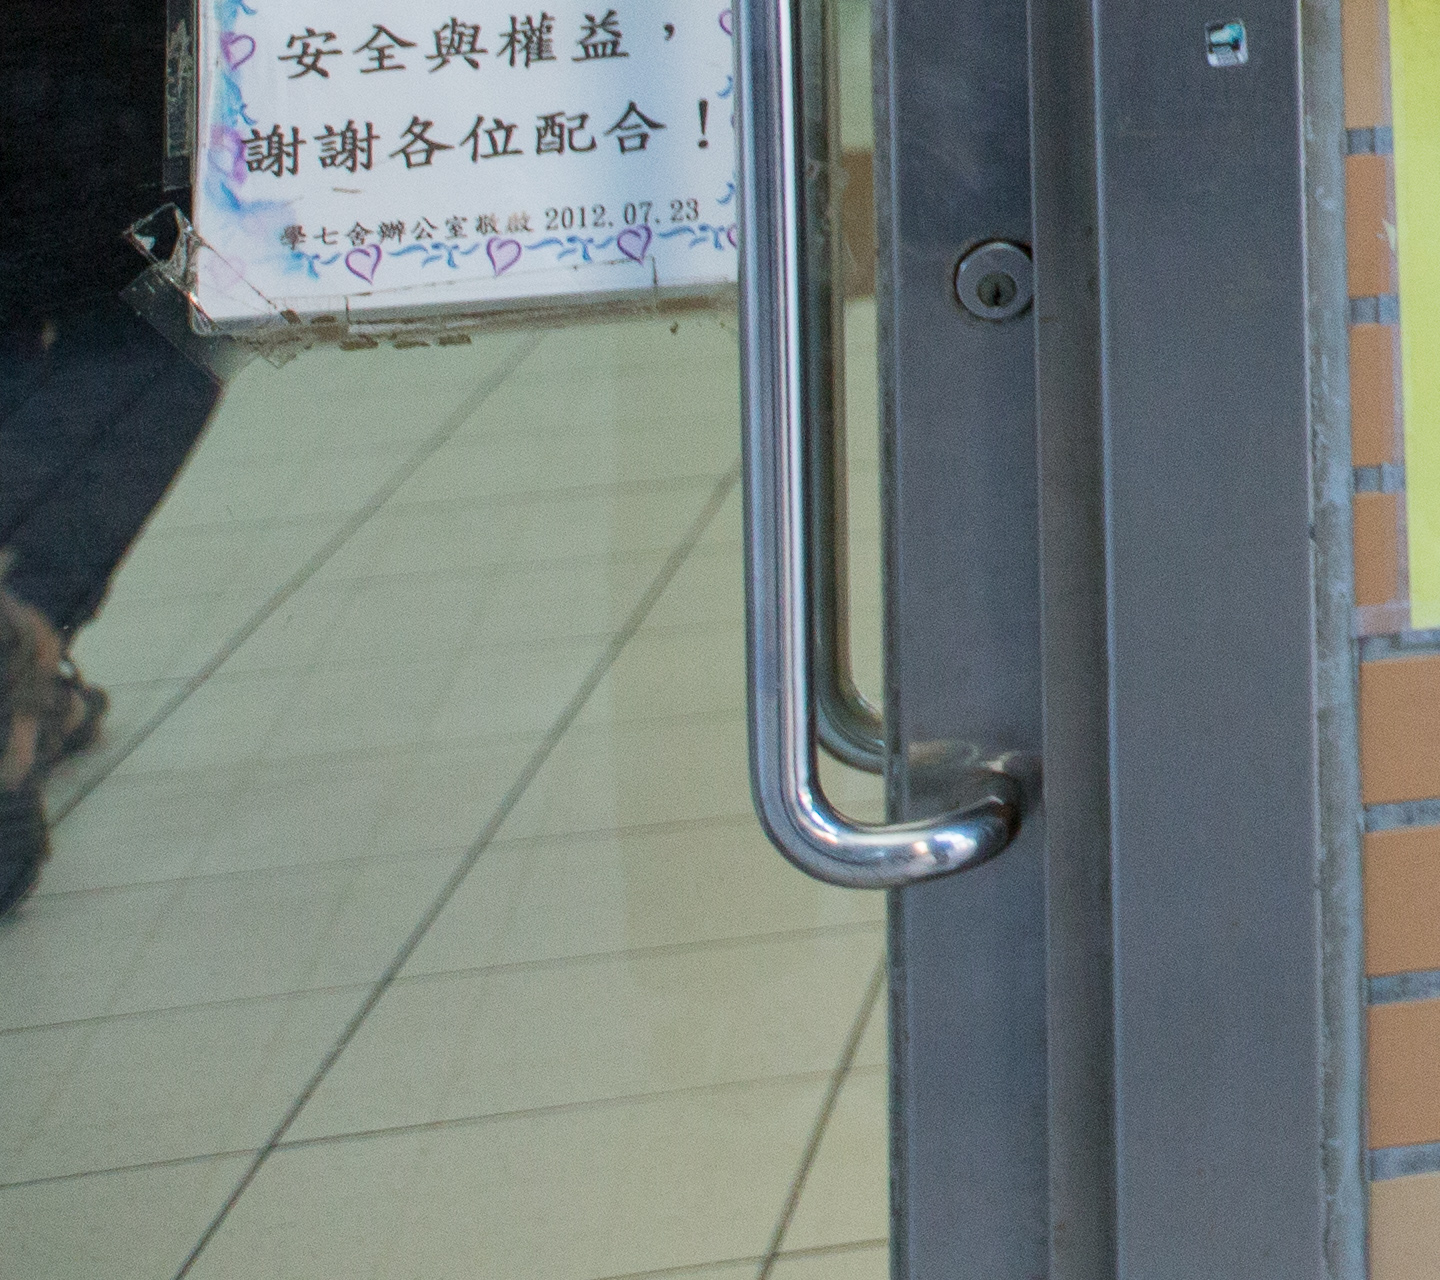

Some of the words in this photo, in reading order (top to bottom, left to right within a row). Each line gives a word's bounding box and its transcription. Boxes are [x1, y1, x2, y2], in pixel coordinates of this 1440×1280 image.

[276, 9, 679, 81] 安全與權益，
[242, 99, 711, 178] 謝謝各位配合！
[544, 198, 700, 231] 2012.07.23
